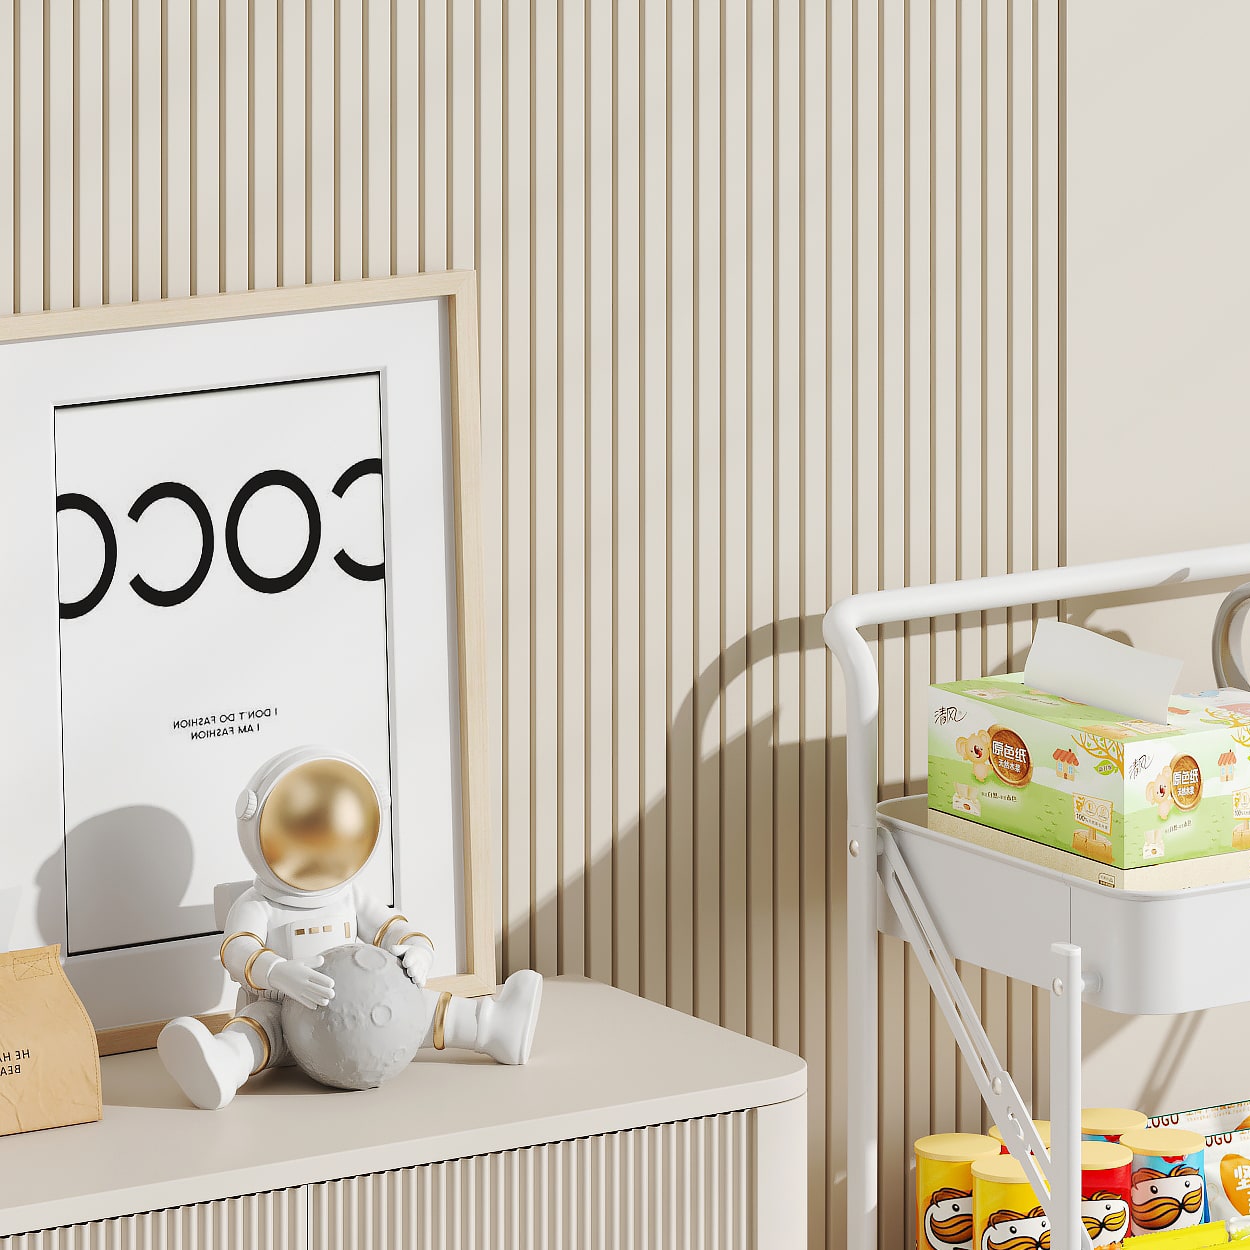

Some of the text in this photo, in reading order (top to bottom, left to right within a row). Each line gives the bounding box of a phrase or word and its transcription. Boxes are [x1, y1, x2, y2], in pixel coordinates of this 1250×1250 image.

[934, 705, 967, 726] 清风
[992, 740, 1027, 764] 原色纸
[1172, 768, 1199, 787] 原色纸
